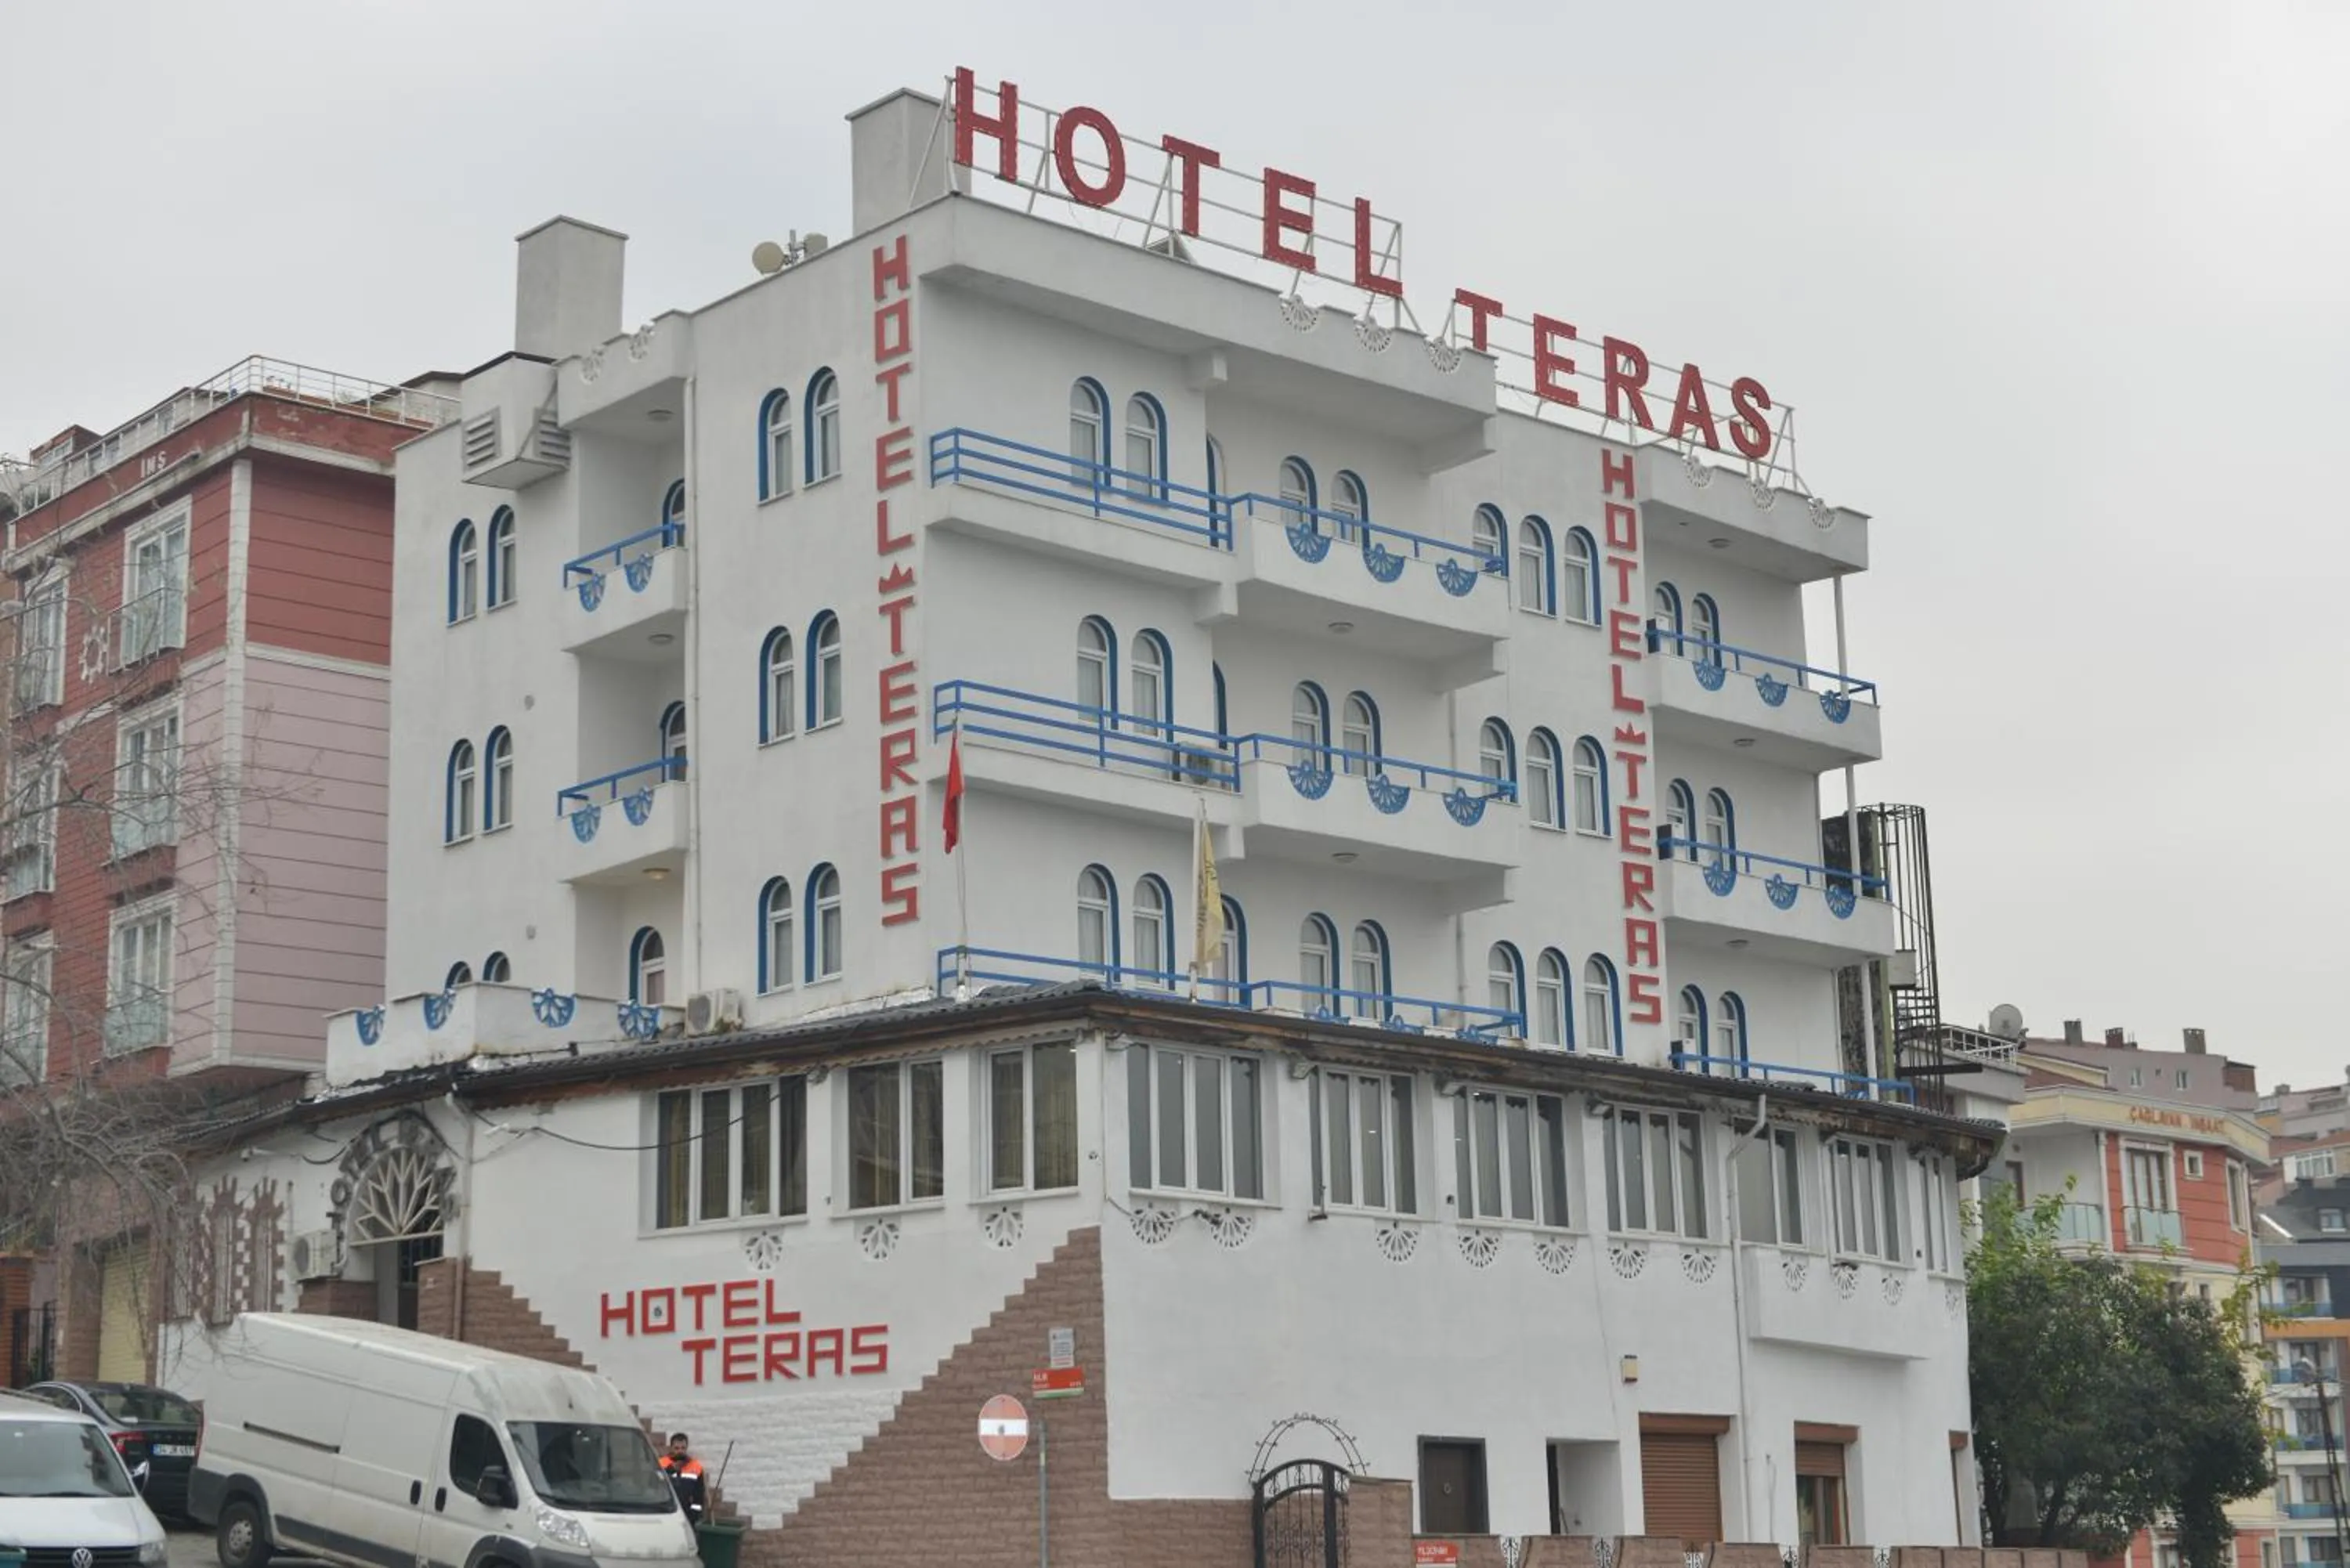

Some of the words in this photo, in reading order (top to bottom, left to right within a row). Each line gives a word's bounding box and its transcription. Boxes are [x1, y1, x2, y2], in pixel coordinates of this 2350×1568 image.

[873, 234, 914, 555] HOTEL
[955, 66, 1403, 296] HOTEL
[1455, 288, 1771, 460] TERAS
[1602, 449, 1644, 714] HOTEL
[878, 595, 920, 927] TERAS
[1615, 751, 1661, 1024] TERAS
[601, 1278, 801, 1338] HOTEL
[681, 1324, 888, 1386] TERAS
